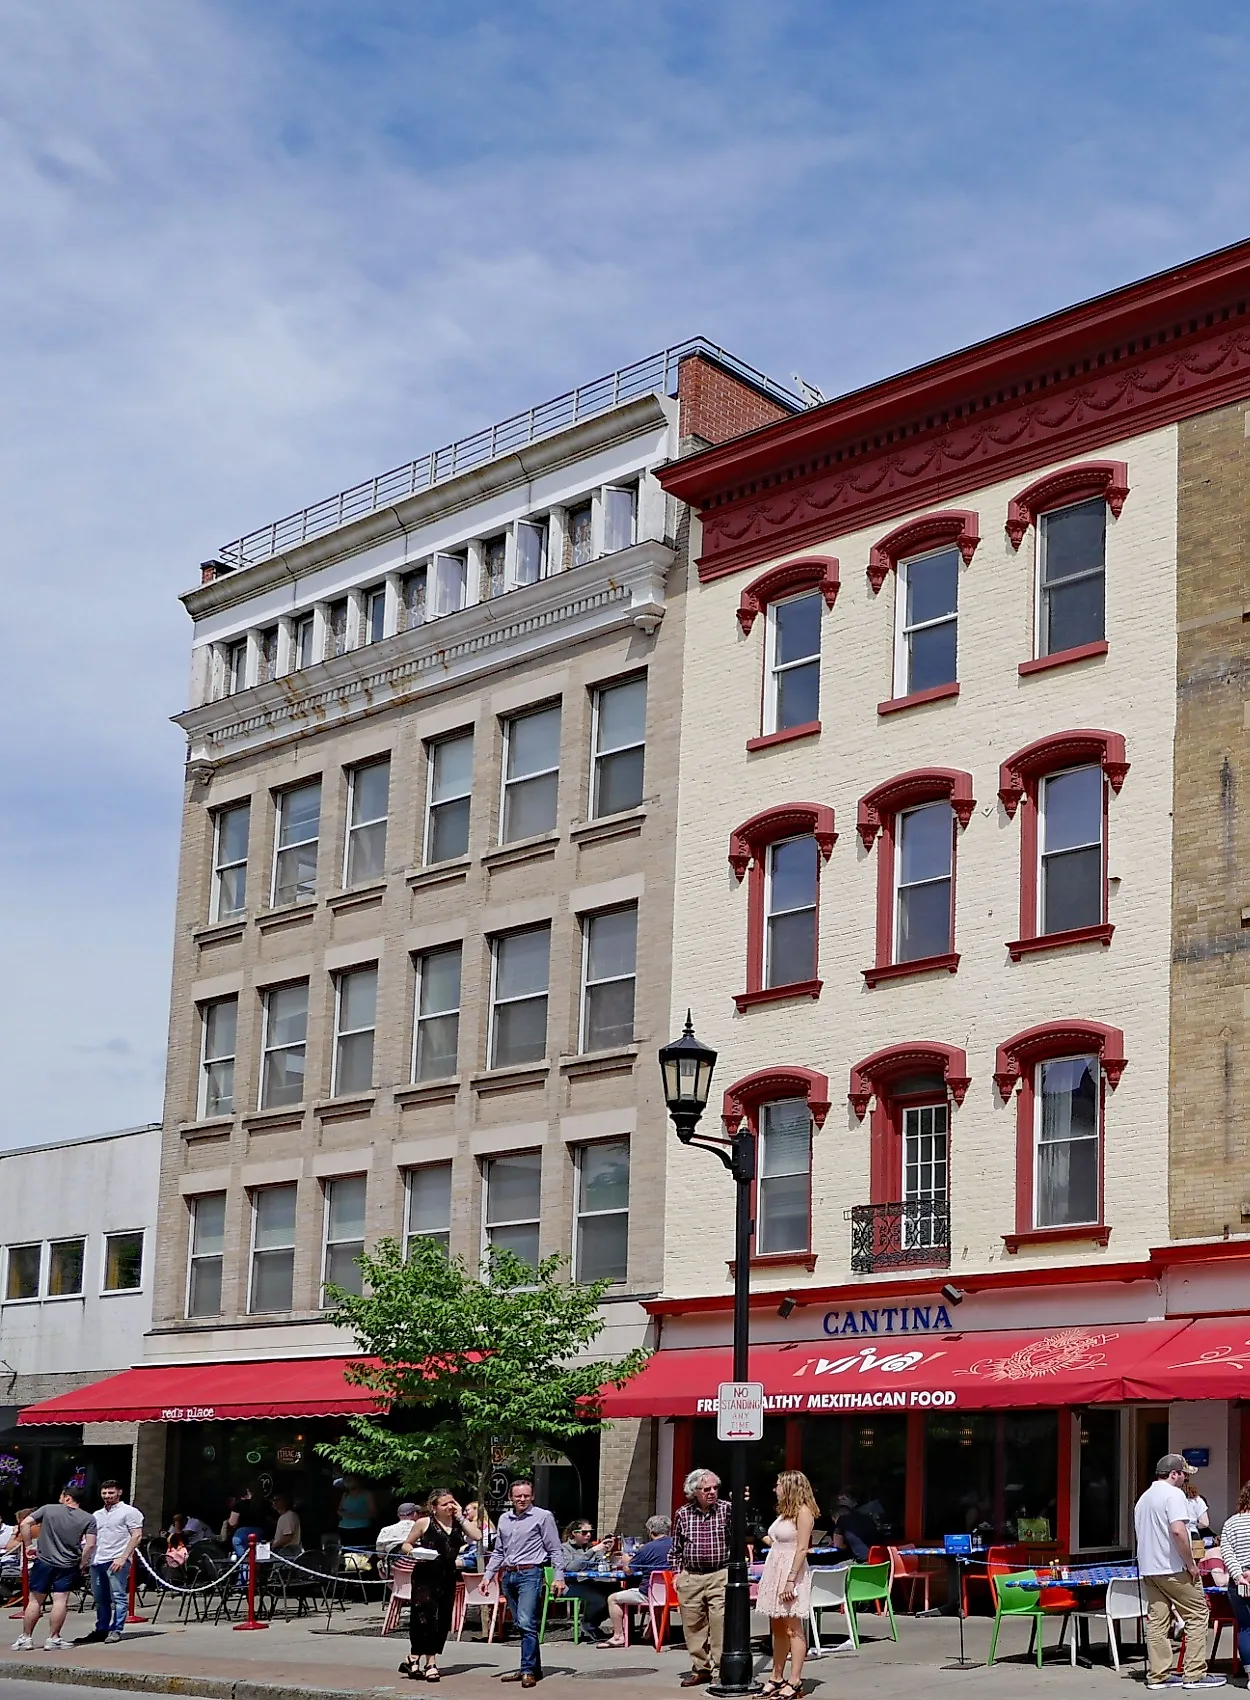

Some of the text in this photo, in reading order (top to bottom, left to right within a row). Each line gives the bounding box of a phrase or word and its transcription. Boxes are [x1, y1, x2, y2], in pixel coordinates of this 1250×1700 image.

[823, 1305, 953, 1335] CANTINA
[733, 1387, 749, 1398] NO
[696, 1390, 957, 1413] FRE ALTHY MEXITHACAN FOOD
[721, 1400, 760, 1410] STANDING
[161, 1407, 215, 1421] red's place
[730, 1421, 750, 1429] TIME
